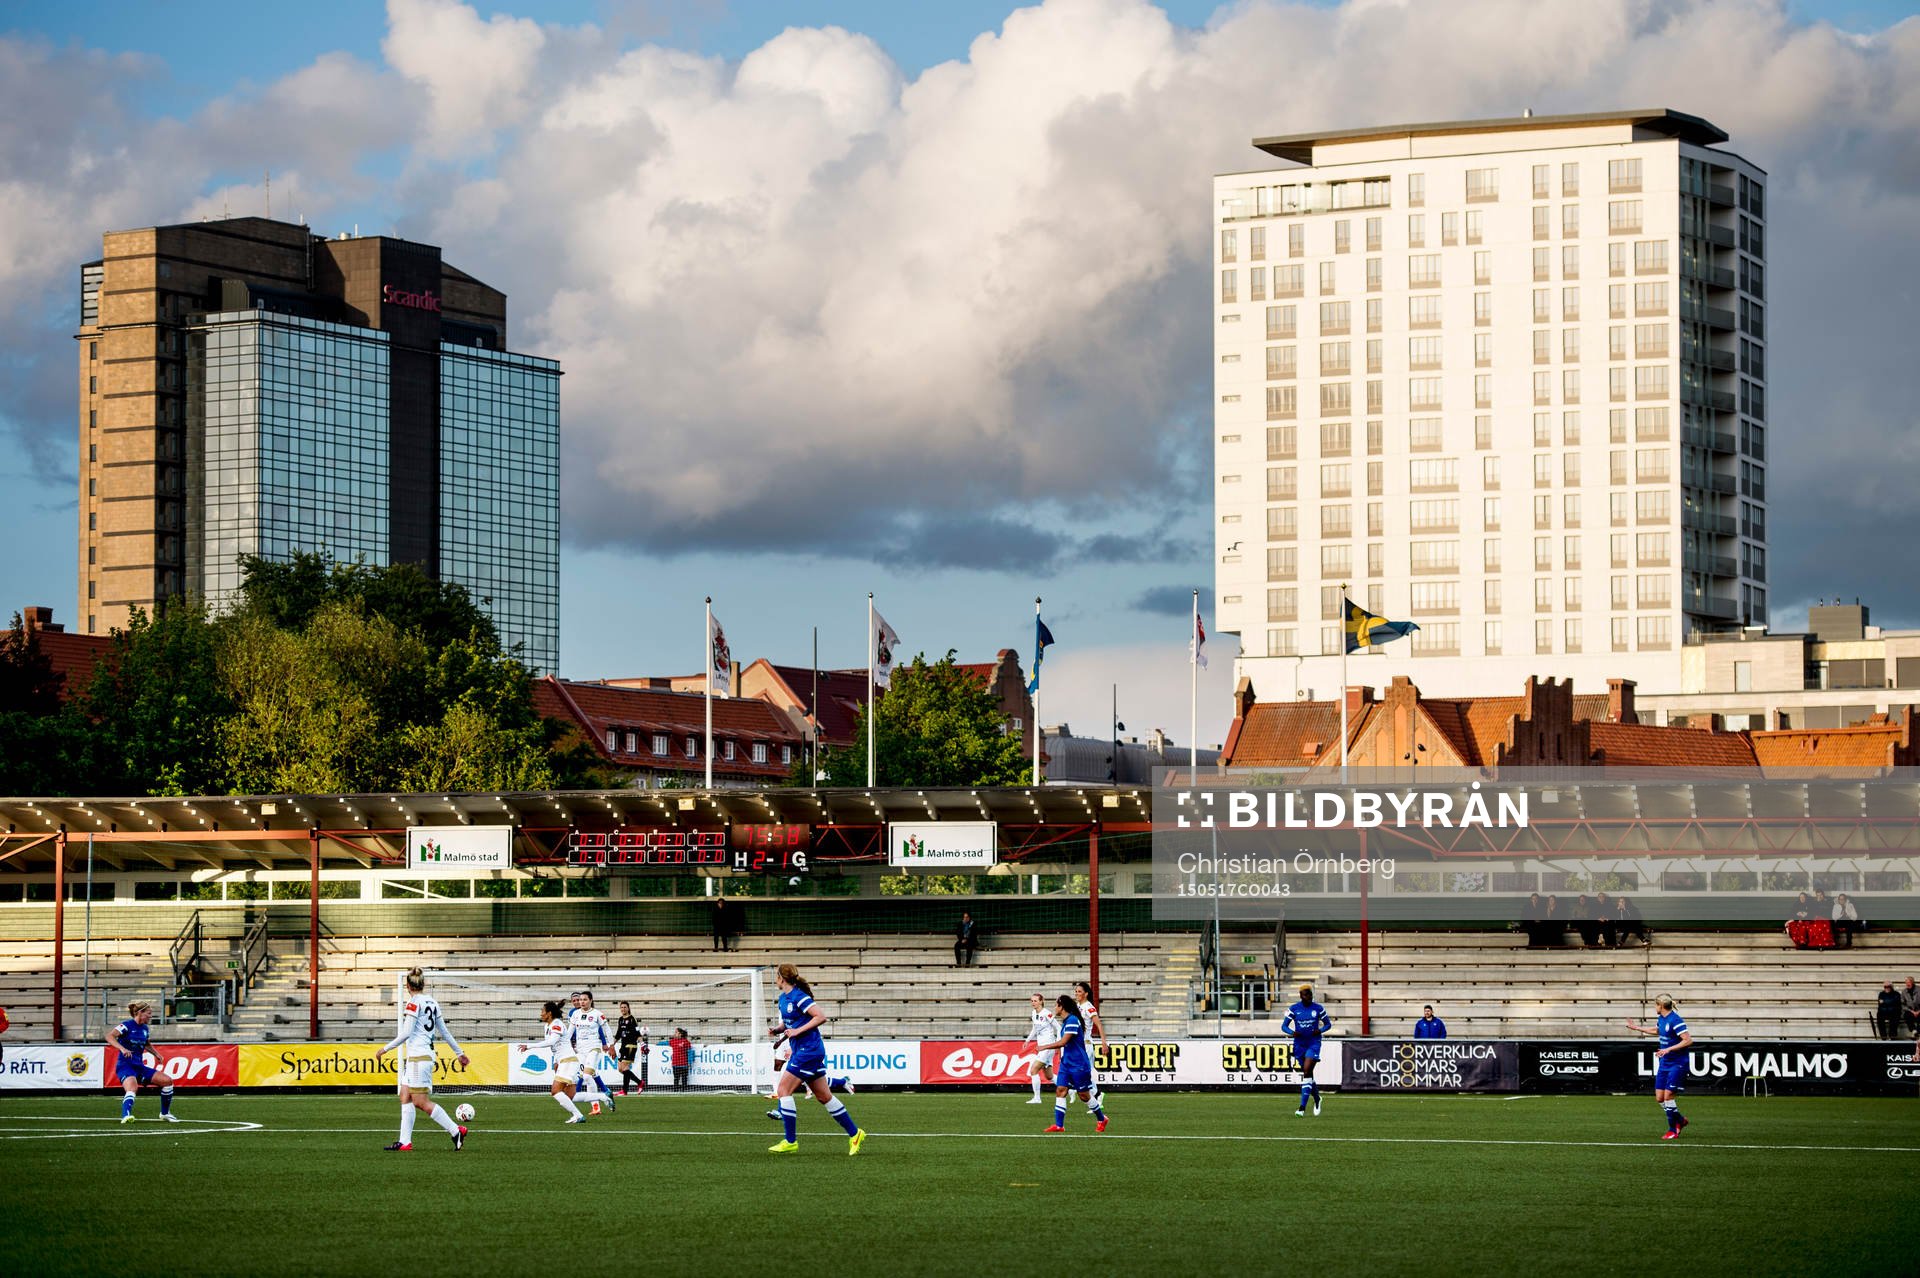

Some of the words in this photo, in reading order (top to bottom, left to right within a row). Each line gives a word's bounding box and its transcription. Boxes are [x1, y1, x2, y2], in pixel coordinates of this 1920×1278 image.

[383, 284, 442, 313] Scandic
[744, 826, 801, 845] 75:58
[443, 851, 476, 862] Malmö
[478, 852, 499, 861] stad
[735, 851, 748, 868] H
[791, 851, 806, 867] G
[927, 848, 960, 858] Malmö
[962, 848, 983, 858] stad
[1094, 1043, 1179, 1072] SPORT
[1392, 1043, 1497, 1059] FÖRVERKLIGA
[1540, 1051, 1579, 1059] KAISER
[1581, 1051, 1599, 1059] BIL
[10, 1058, 48, 1074] RÄTT.
[824, 1054, 907, 1070] HILDING
[1353, 1059, 1457, 1073] UNGDOMARS
[1556, 1066, 1599, 1074] LEXUS
[1637, 1052, 1728, 1077] LUS
[1734, 1052, 1848, 1078] MALMÖ
[717, 1066, 733, 1075] och
[1097, 1073, 1176, 1082] BLADET
[1380, 1072, 1462, 1088] DRÖMMAR
